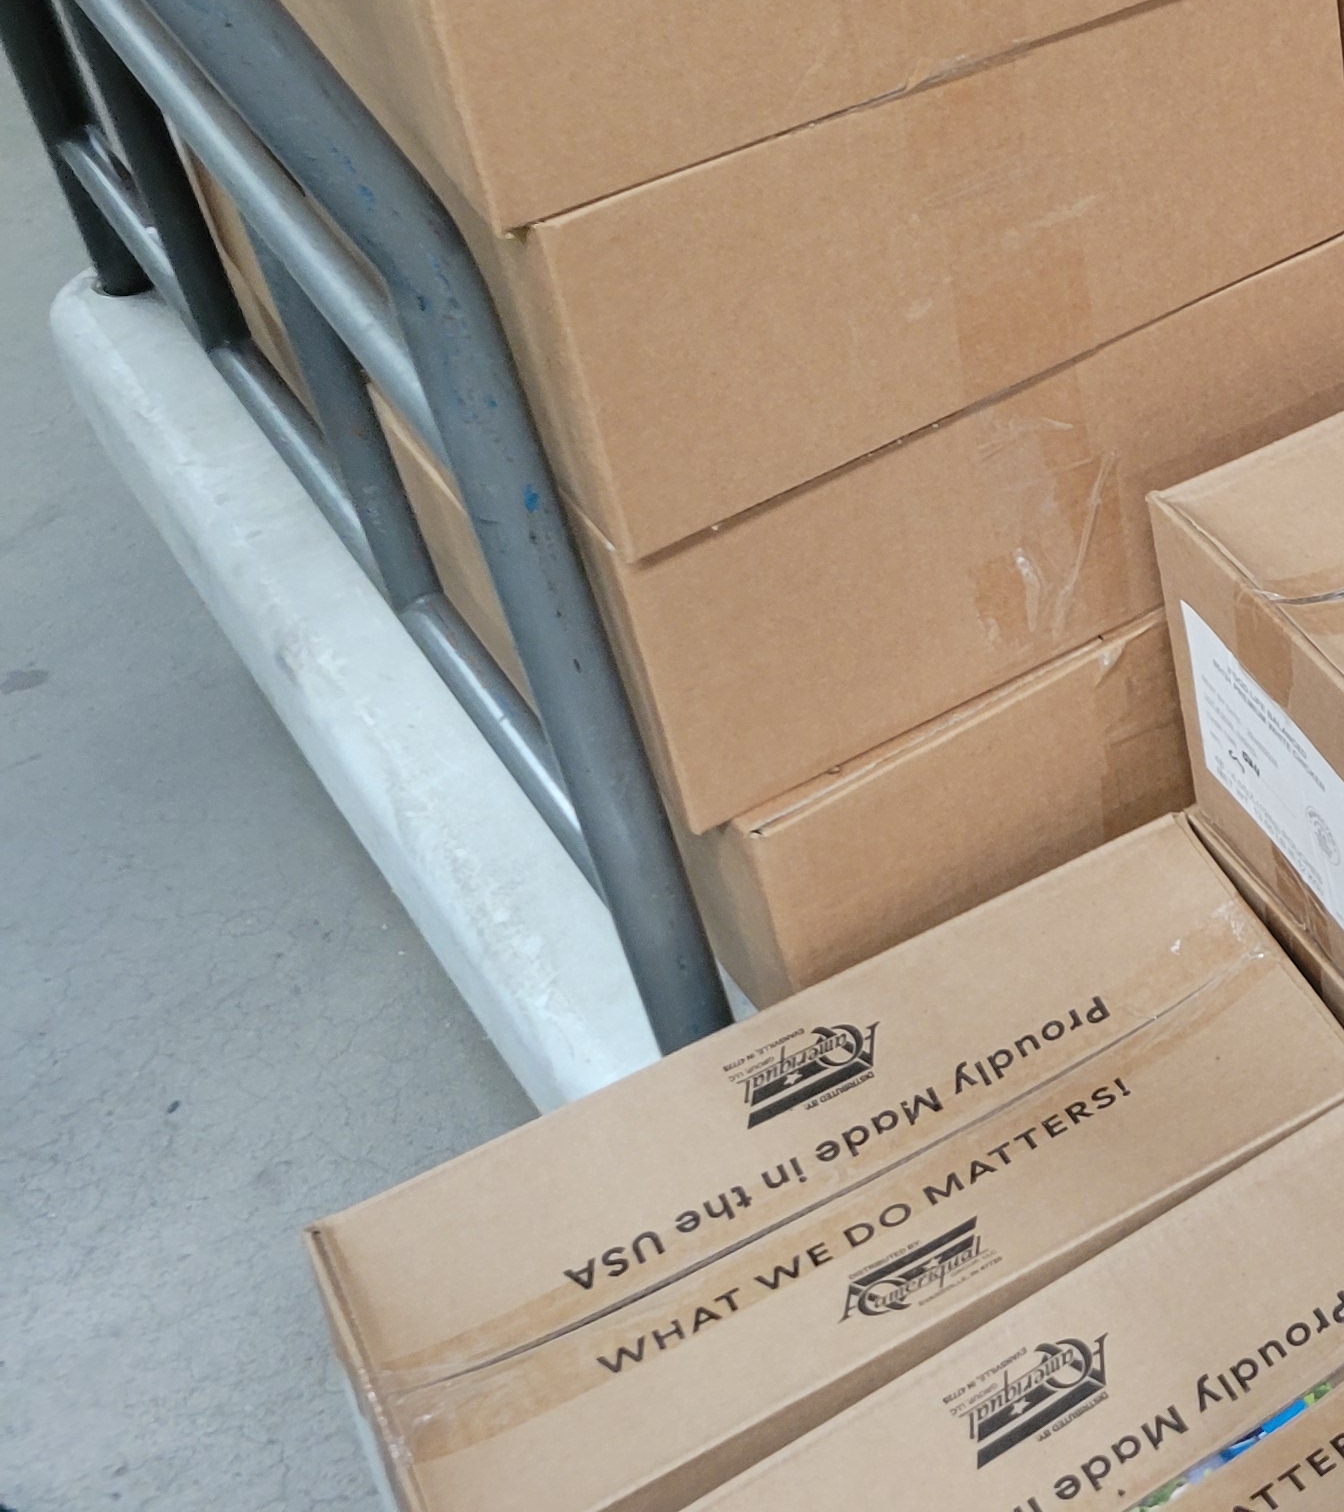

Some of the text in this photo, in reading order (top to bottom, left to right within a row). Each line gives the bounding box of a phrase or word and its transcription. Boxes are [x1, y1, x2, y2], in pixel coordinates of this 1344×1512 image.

[564, 996, 1111, 1289] Proudly Made in the USA
[596, 1076, 1131, 1373] WHAT WE DO MATTERS!
[1054, 1405, 1189, 1500] Made
